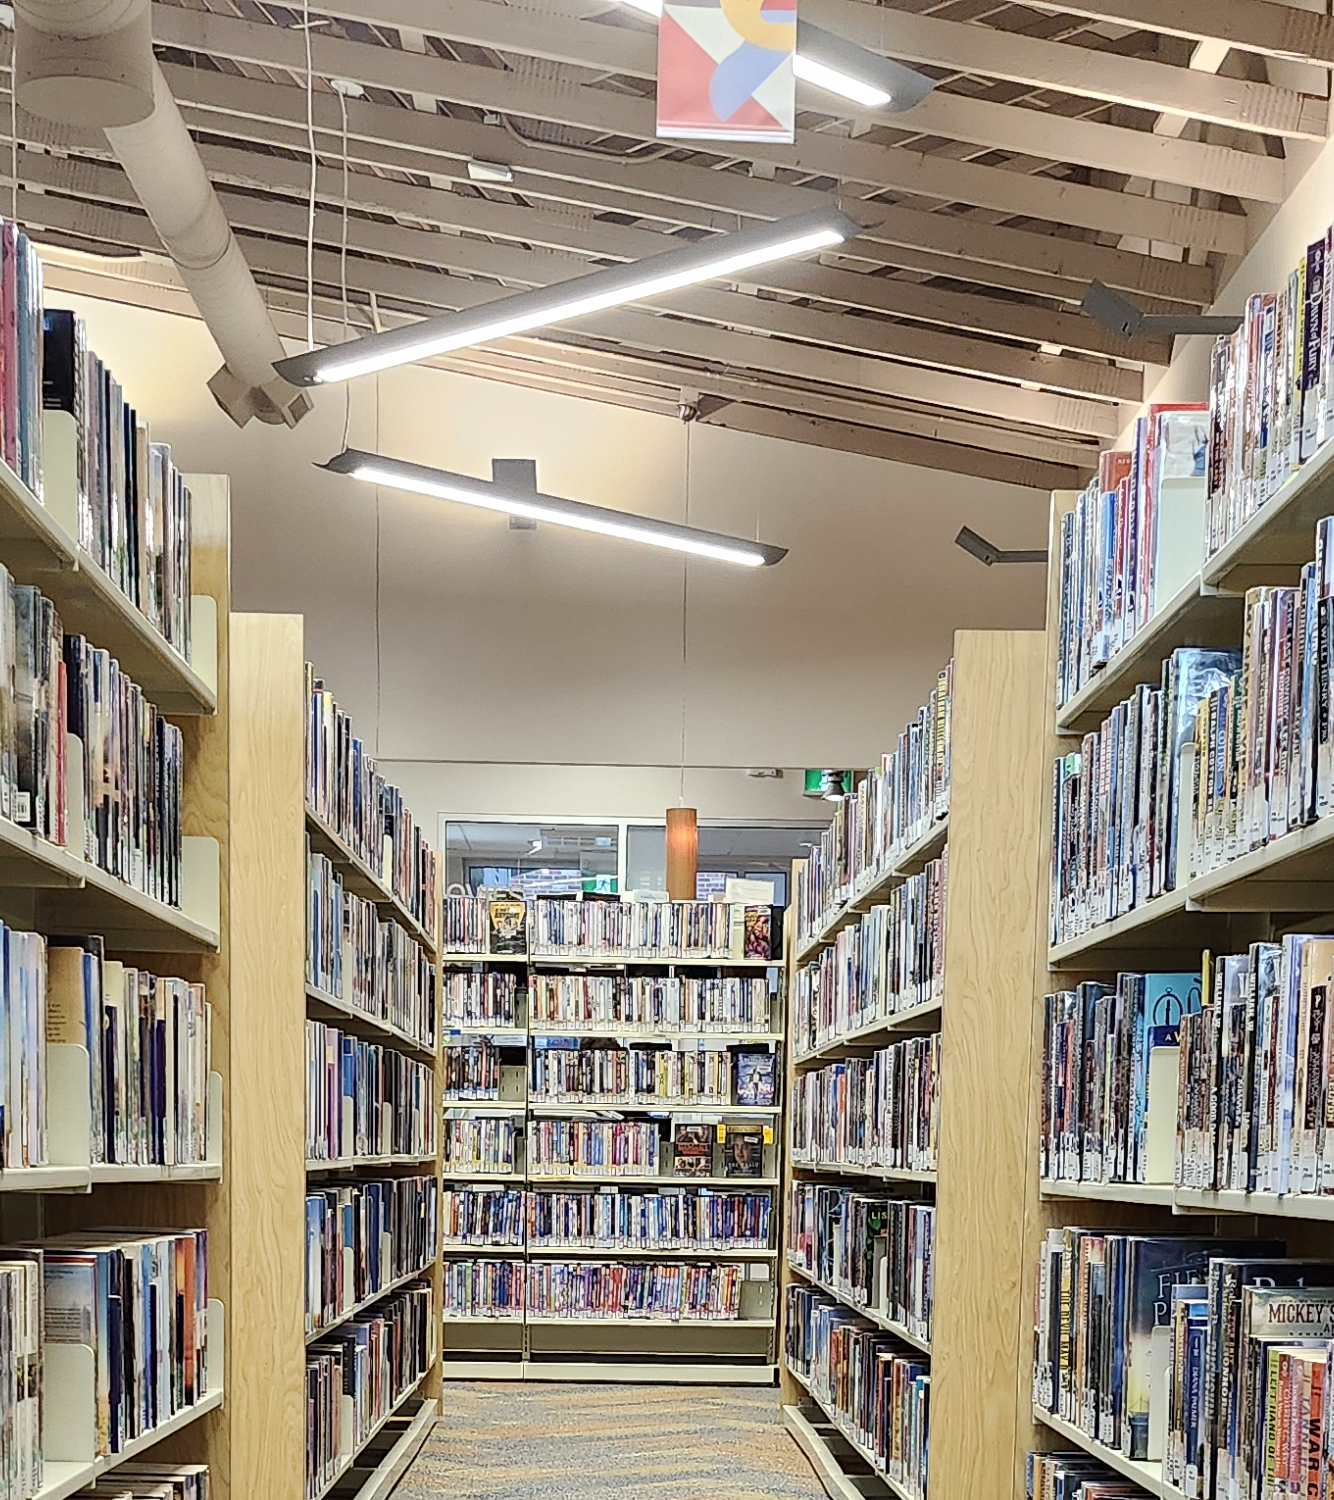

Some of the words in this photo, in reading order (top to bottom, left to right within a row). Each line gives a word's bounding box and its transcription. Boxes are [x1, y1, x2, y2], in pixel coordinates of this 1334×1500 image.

[1268, 1303, 1325, 1324] MICKEY
[1269, 1369, 1278, 1400] LEFT
[1268, 1403, 1277, 1441] HAND
[1307, 1418, 1320, 1476] WAR
